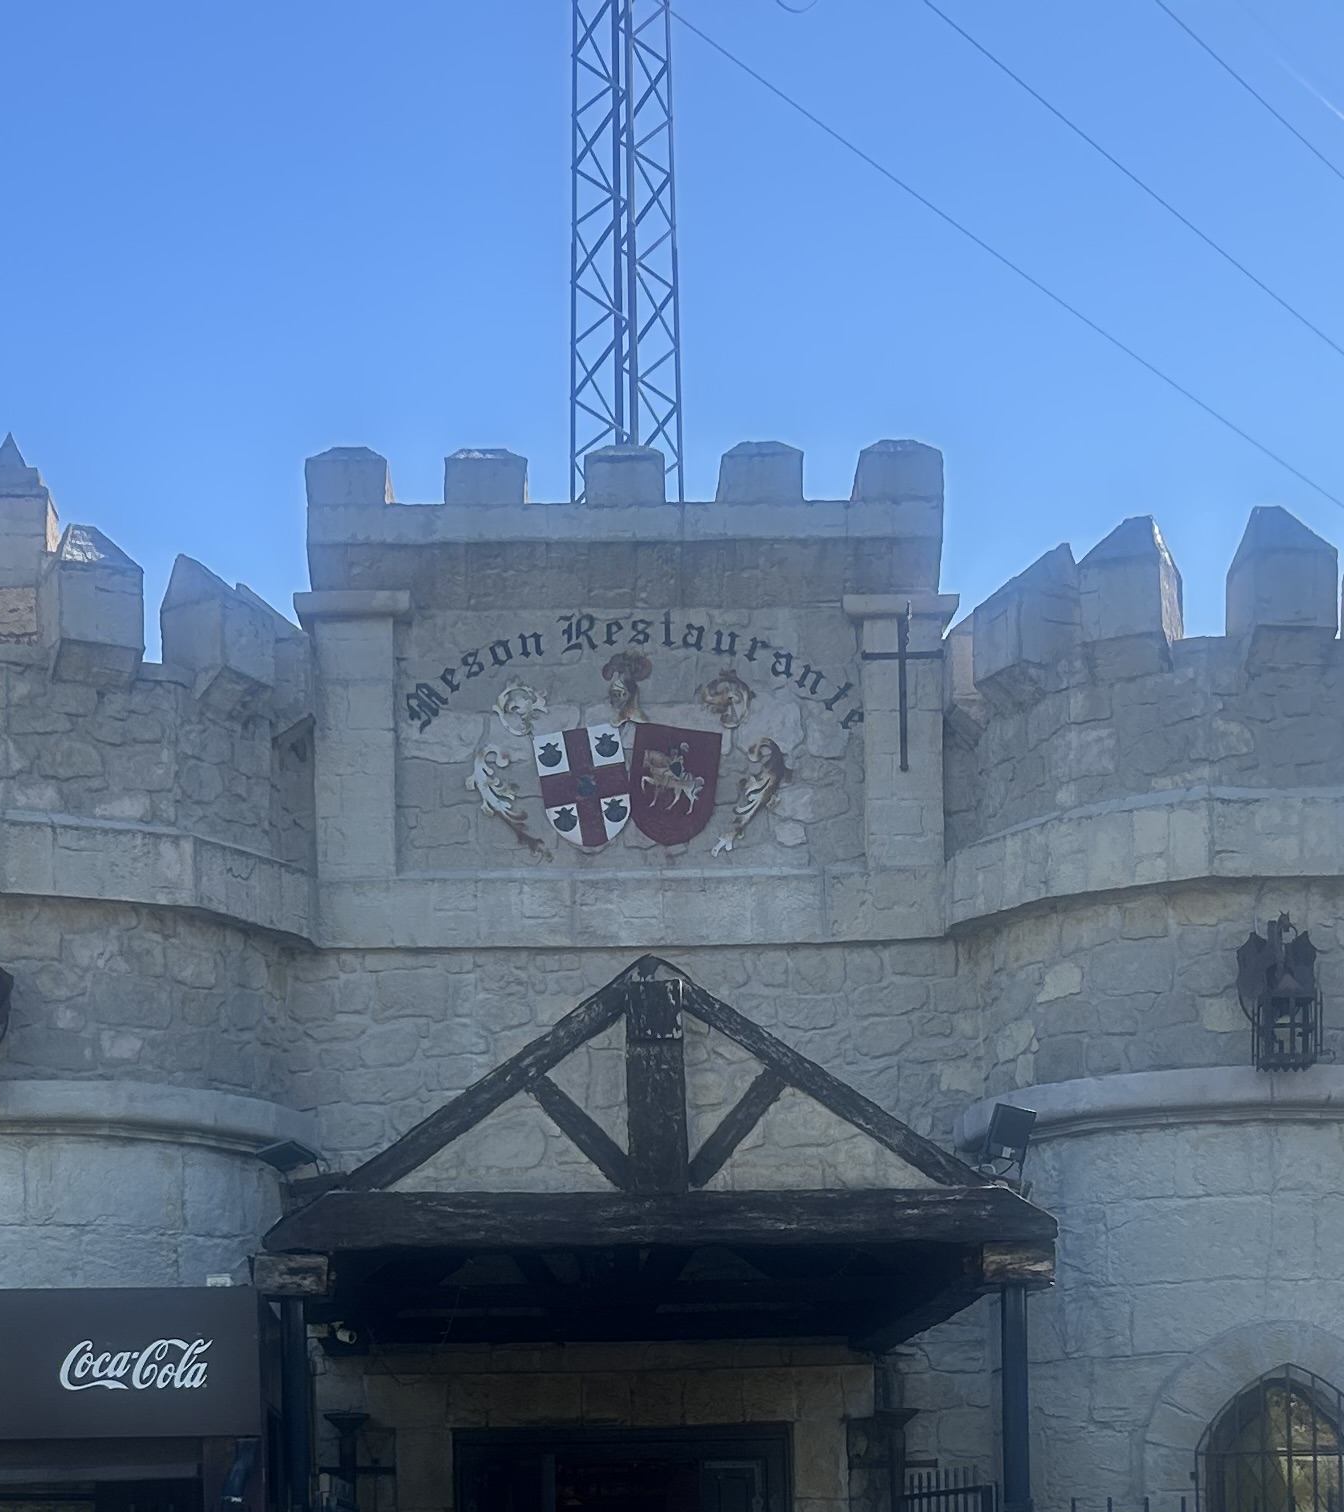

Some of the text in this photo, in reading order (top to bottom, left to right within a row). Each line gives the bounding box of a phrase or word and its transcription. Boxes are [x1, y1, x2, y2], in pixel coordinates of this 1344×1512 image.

[406, 610, 864, 734] Meson Restaurante
[59, 1338, 213, 1390] Coca-Cola
